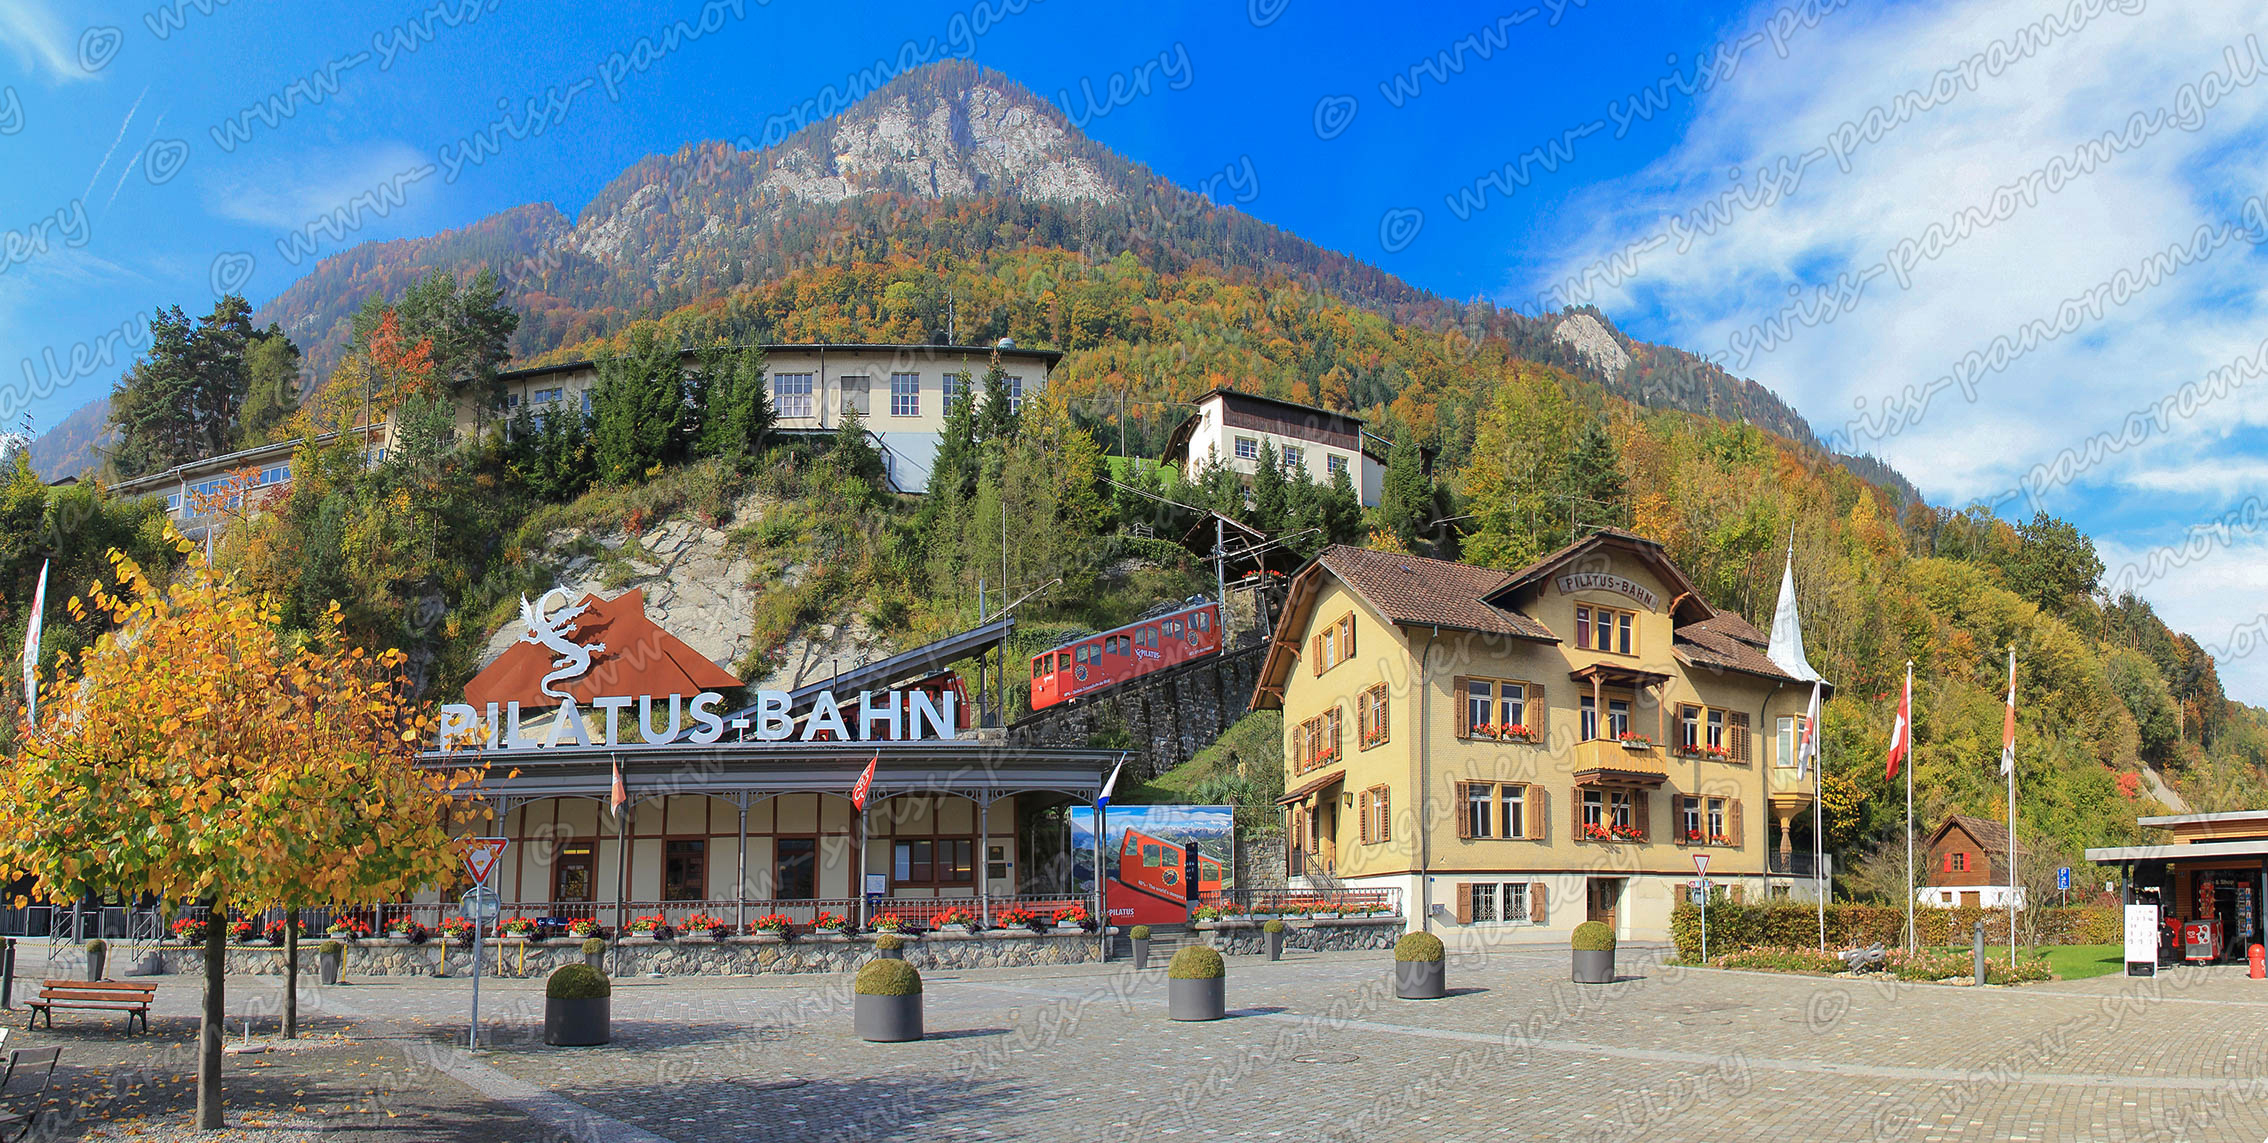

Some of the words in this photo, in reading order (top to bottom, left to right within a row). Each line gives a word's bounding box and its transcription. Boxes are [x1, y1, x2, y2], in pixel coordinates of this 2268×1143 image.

[1566, 574, 1653, 604] PILATUS-BAHN
[440, 690, 956, 752] PILATUS-BAHN
[1109, 908, 1135, 918] PILATUS
